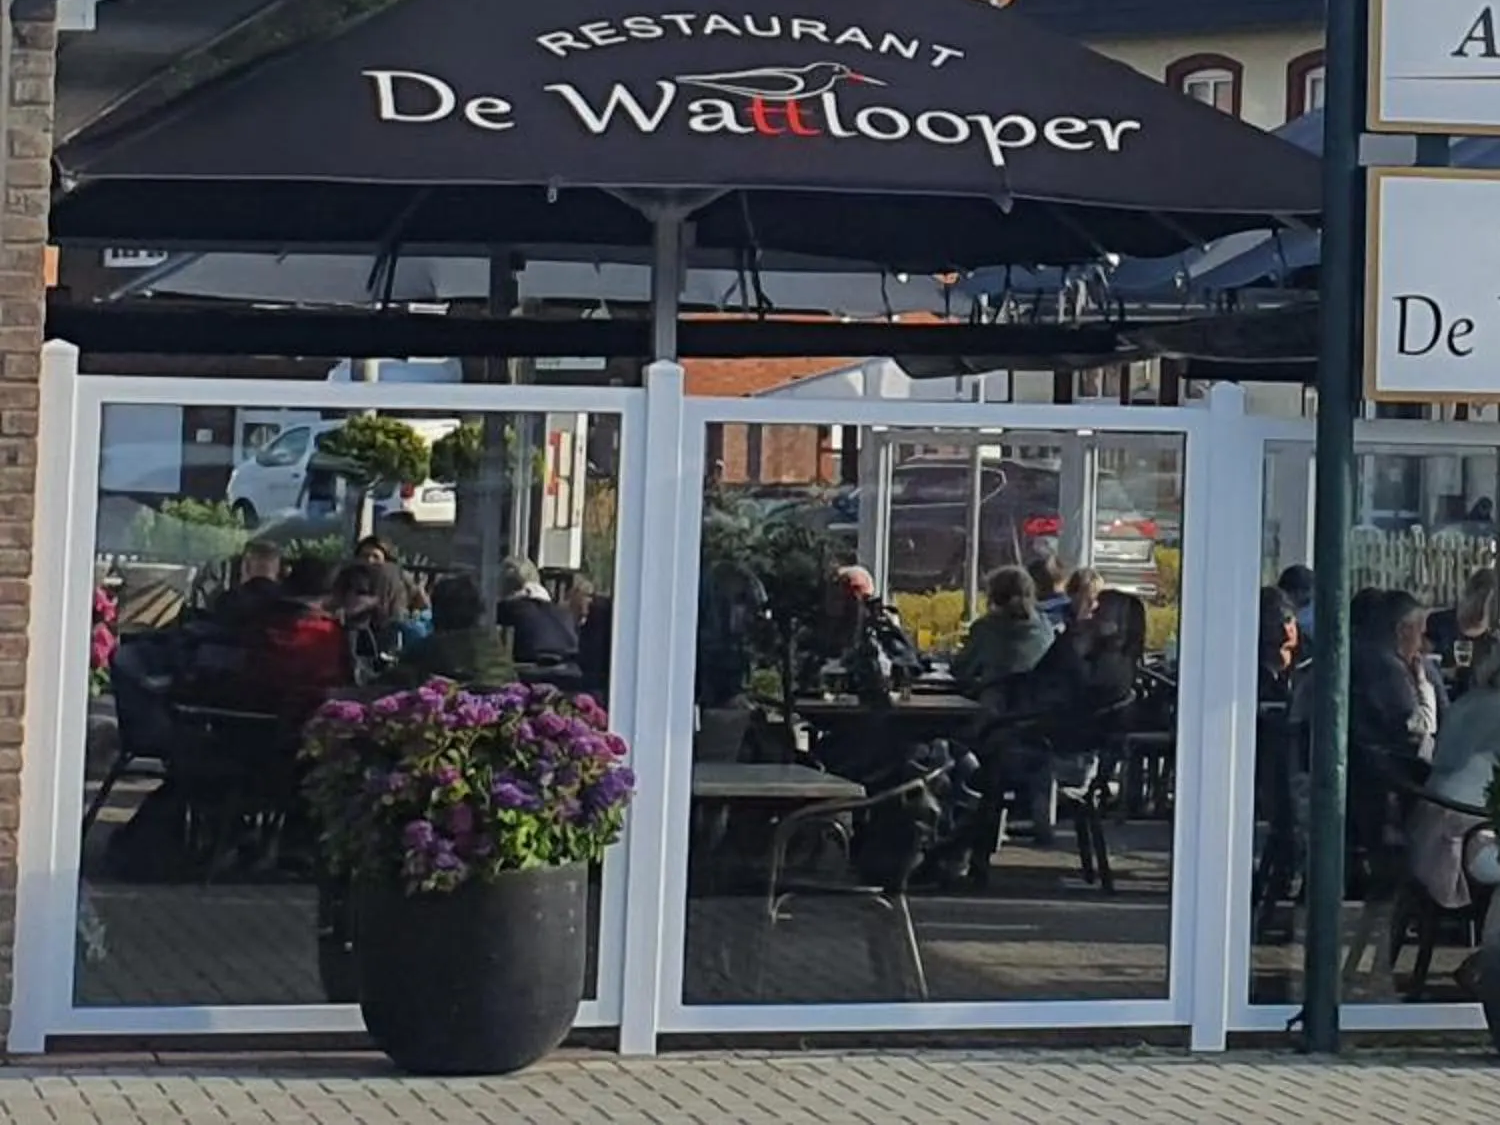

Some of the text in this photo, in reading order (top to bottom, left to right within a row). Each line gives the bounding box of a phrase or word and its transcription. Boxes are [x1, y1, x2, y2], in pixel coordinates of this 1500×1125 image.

[536, 13, 966, 69] RESTAURANT
[361, 69, 1142, 167] De Wattlooper
[1393, 295, 1476, 358] De
